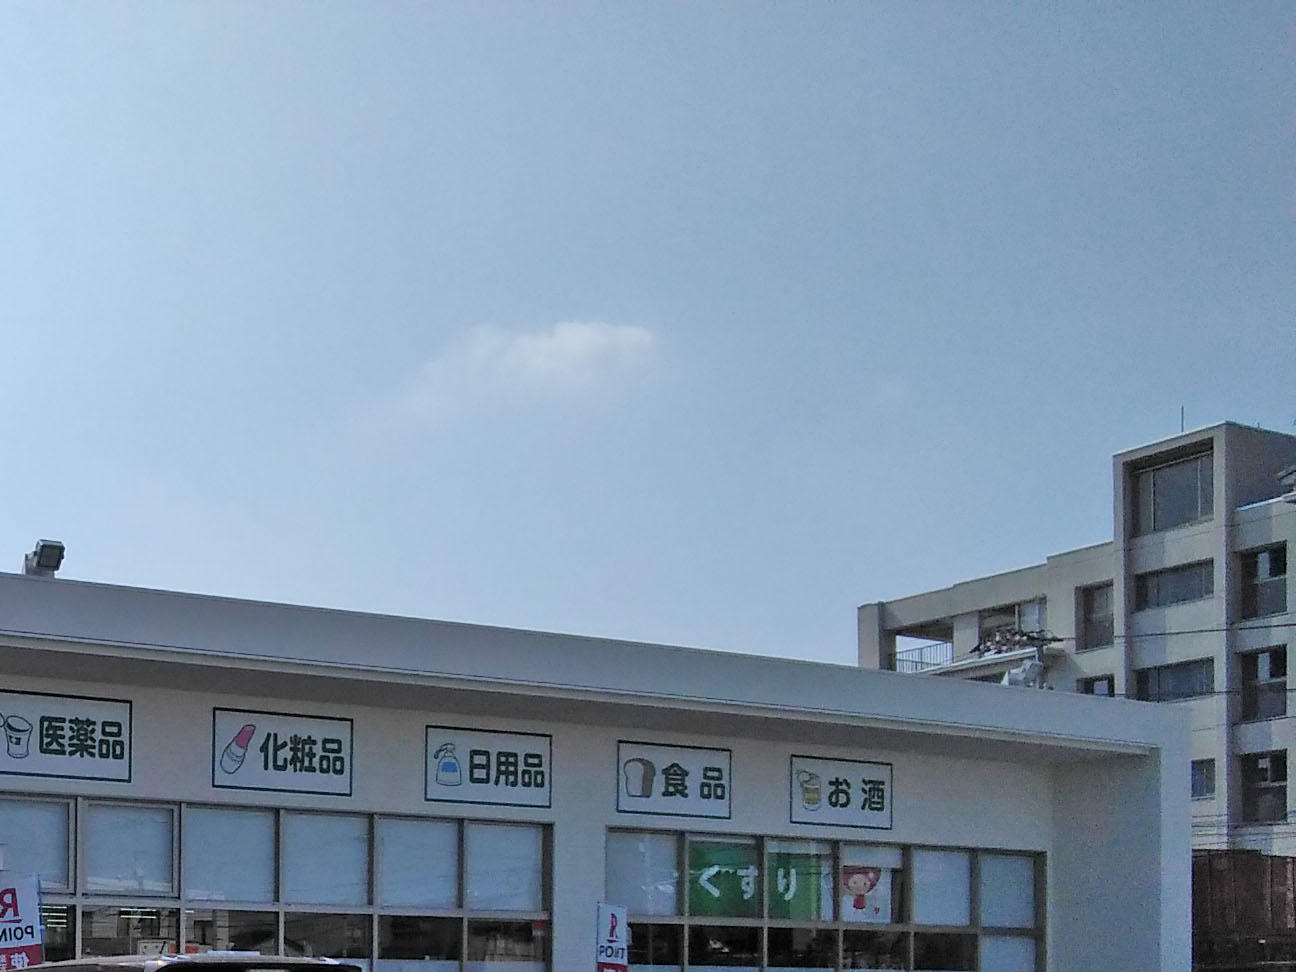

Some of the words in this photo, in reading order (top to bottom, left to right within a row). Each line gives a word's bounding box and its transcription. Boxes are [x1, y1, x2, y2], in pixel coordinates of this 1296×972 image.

[39, 715, 125, 761] 医薬品
[259, 731, 345, 776] 化粧品
[468, 748, 545, 789] 日用品
[661, 762, 726, 801] 食品
[827, 776, 886, 812] お酒
[698, 864, 797, 901] くすり
